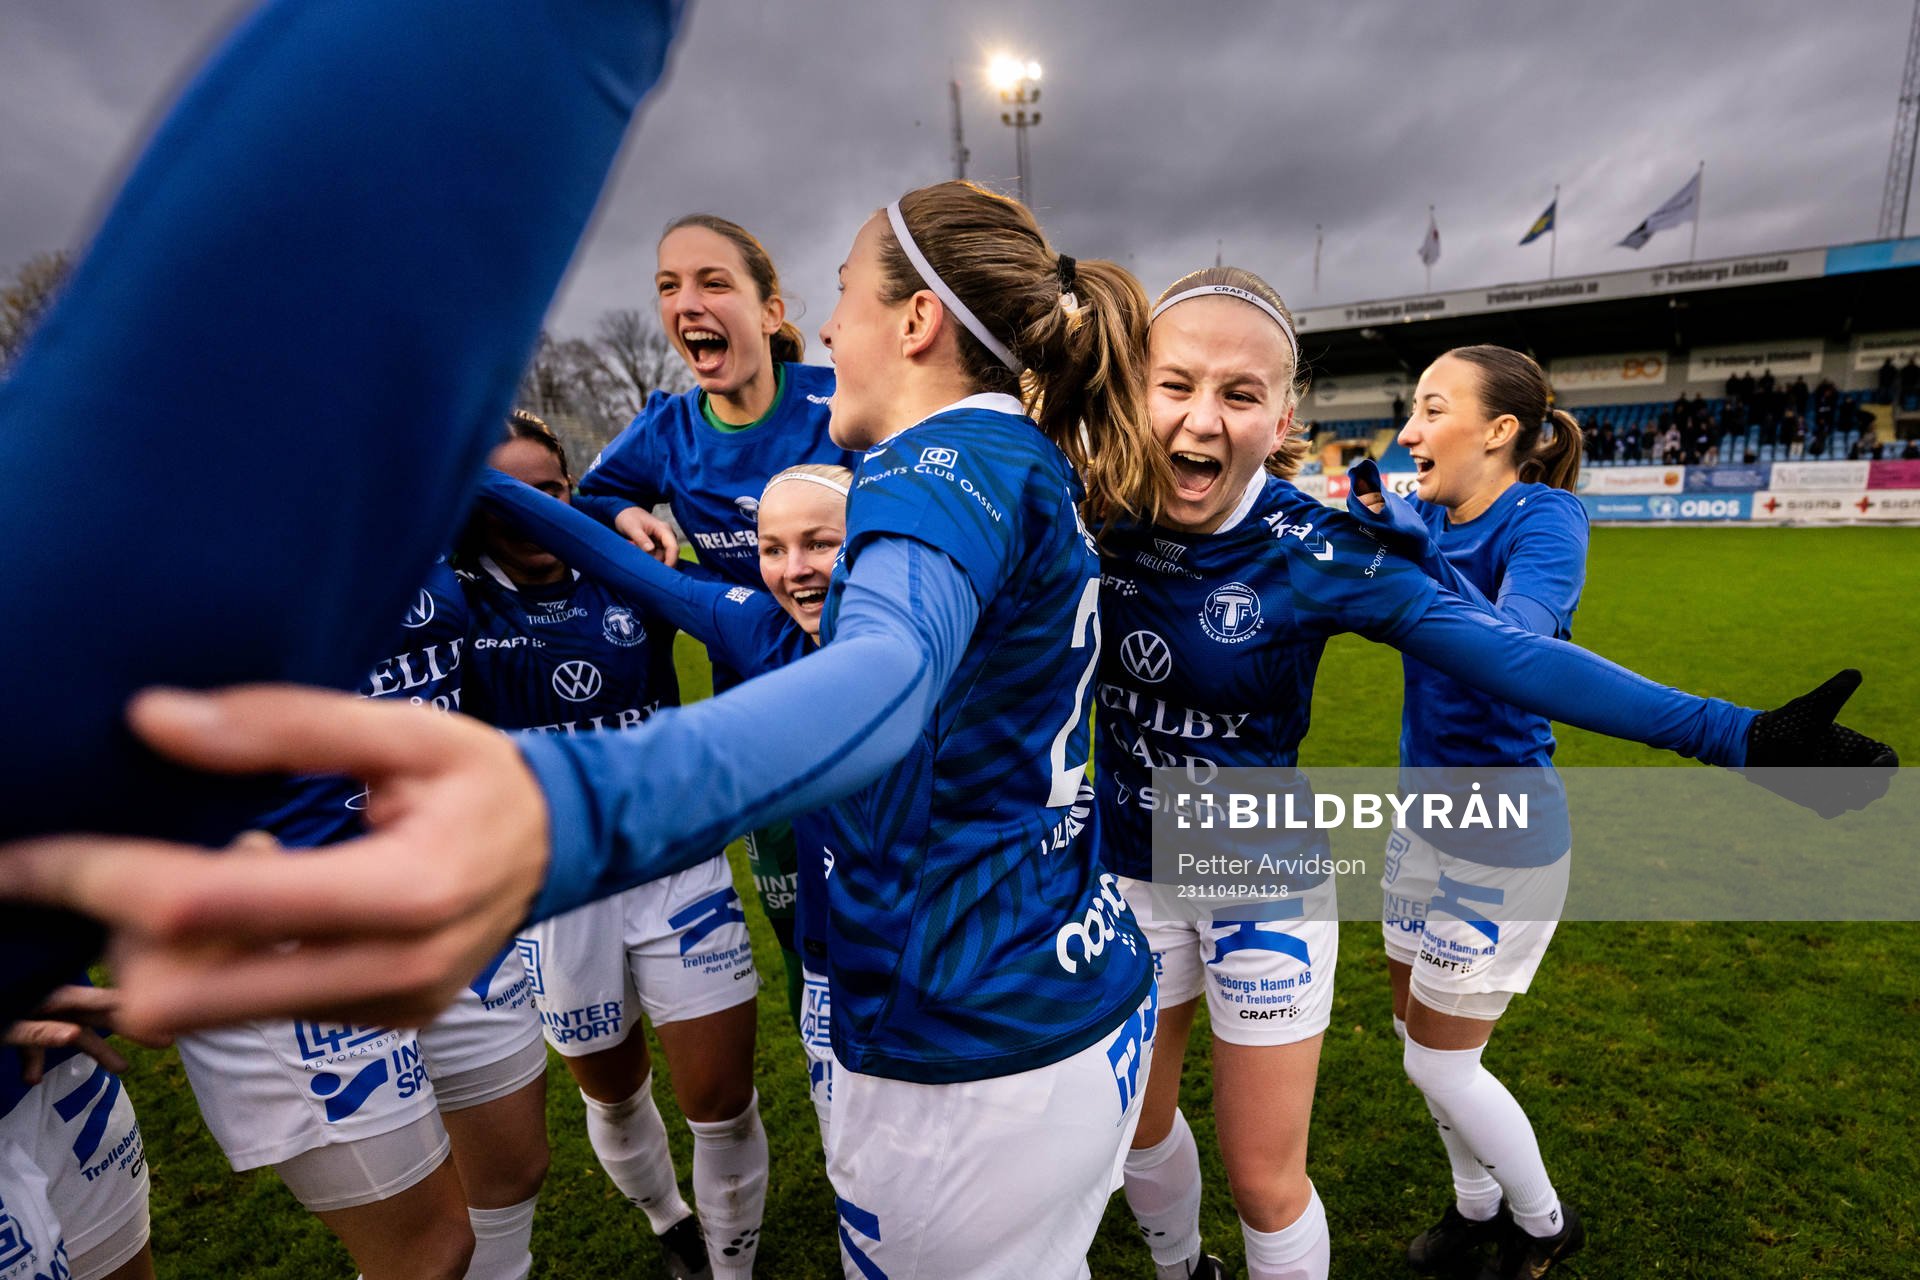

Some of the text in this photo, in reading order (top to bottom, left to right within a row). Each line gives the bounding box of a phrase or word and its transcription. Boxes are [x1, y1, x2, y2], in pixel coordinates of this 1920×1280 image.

[1214, 286, 1250, 298] CRAFT
[857, 463, 1002, 522] SPORTS CLUB OASEN
[1680, 500, 1740, 518] OBOS
[474, 637, 528, 650] CRAFT
[766, 892, 797, 910] SP
[1450, 941, 1478, 956] Hamn
[1482, 945, 1496, 956] AB
[682, 948, 739, 969] Trelleborgs
[1420, 949, 1459, 972] CRAFT
[1260, 977, 1295, 992] Hamn
[1298, 971, 1312, 986] AB
[1235, 993, 1245, 1003] of
[546, 1001, 622, 1028] INTER
[1239, 1008, 1288, 1020] CRAFT
[552, 1017, 622, 1044] SPORT
